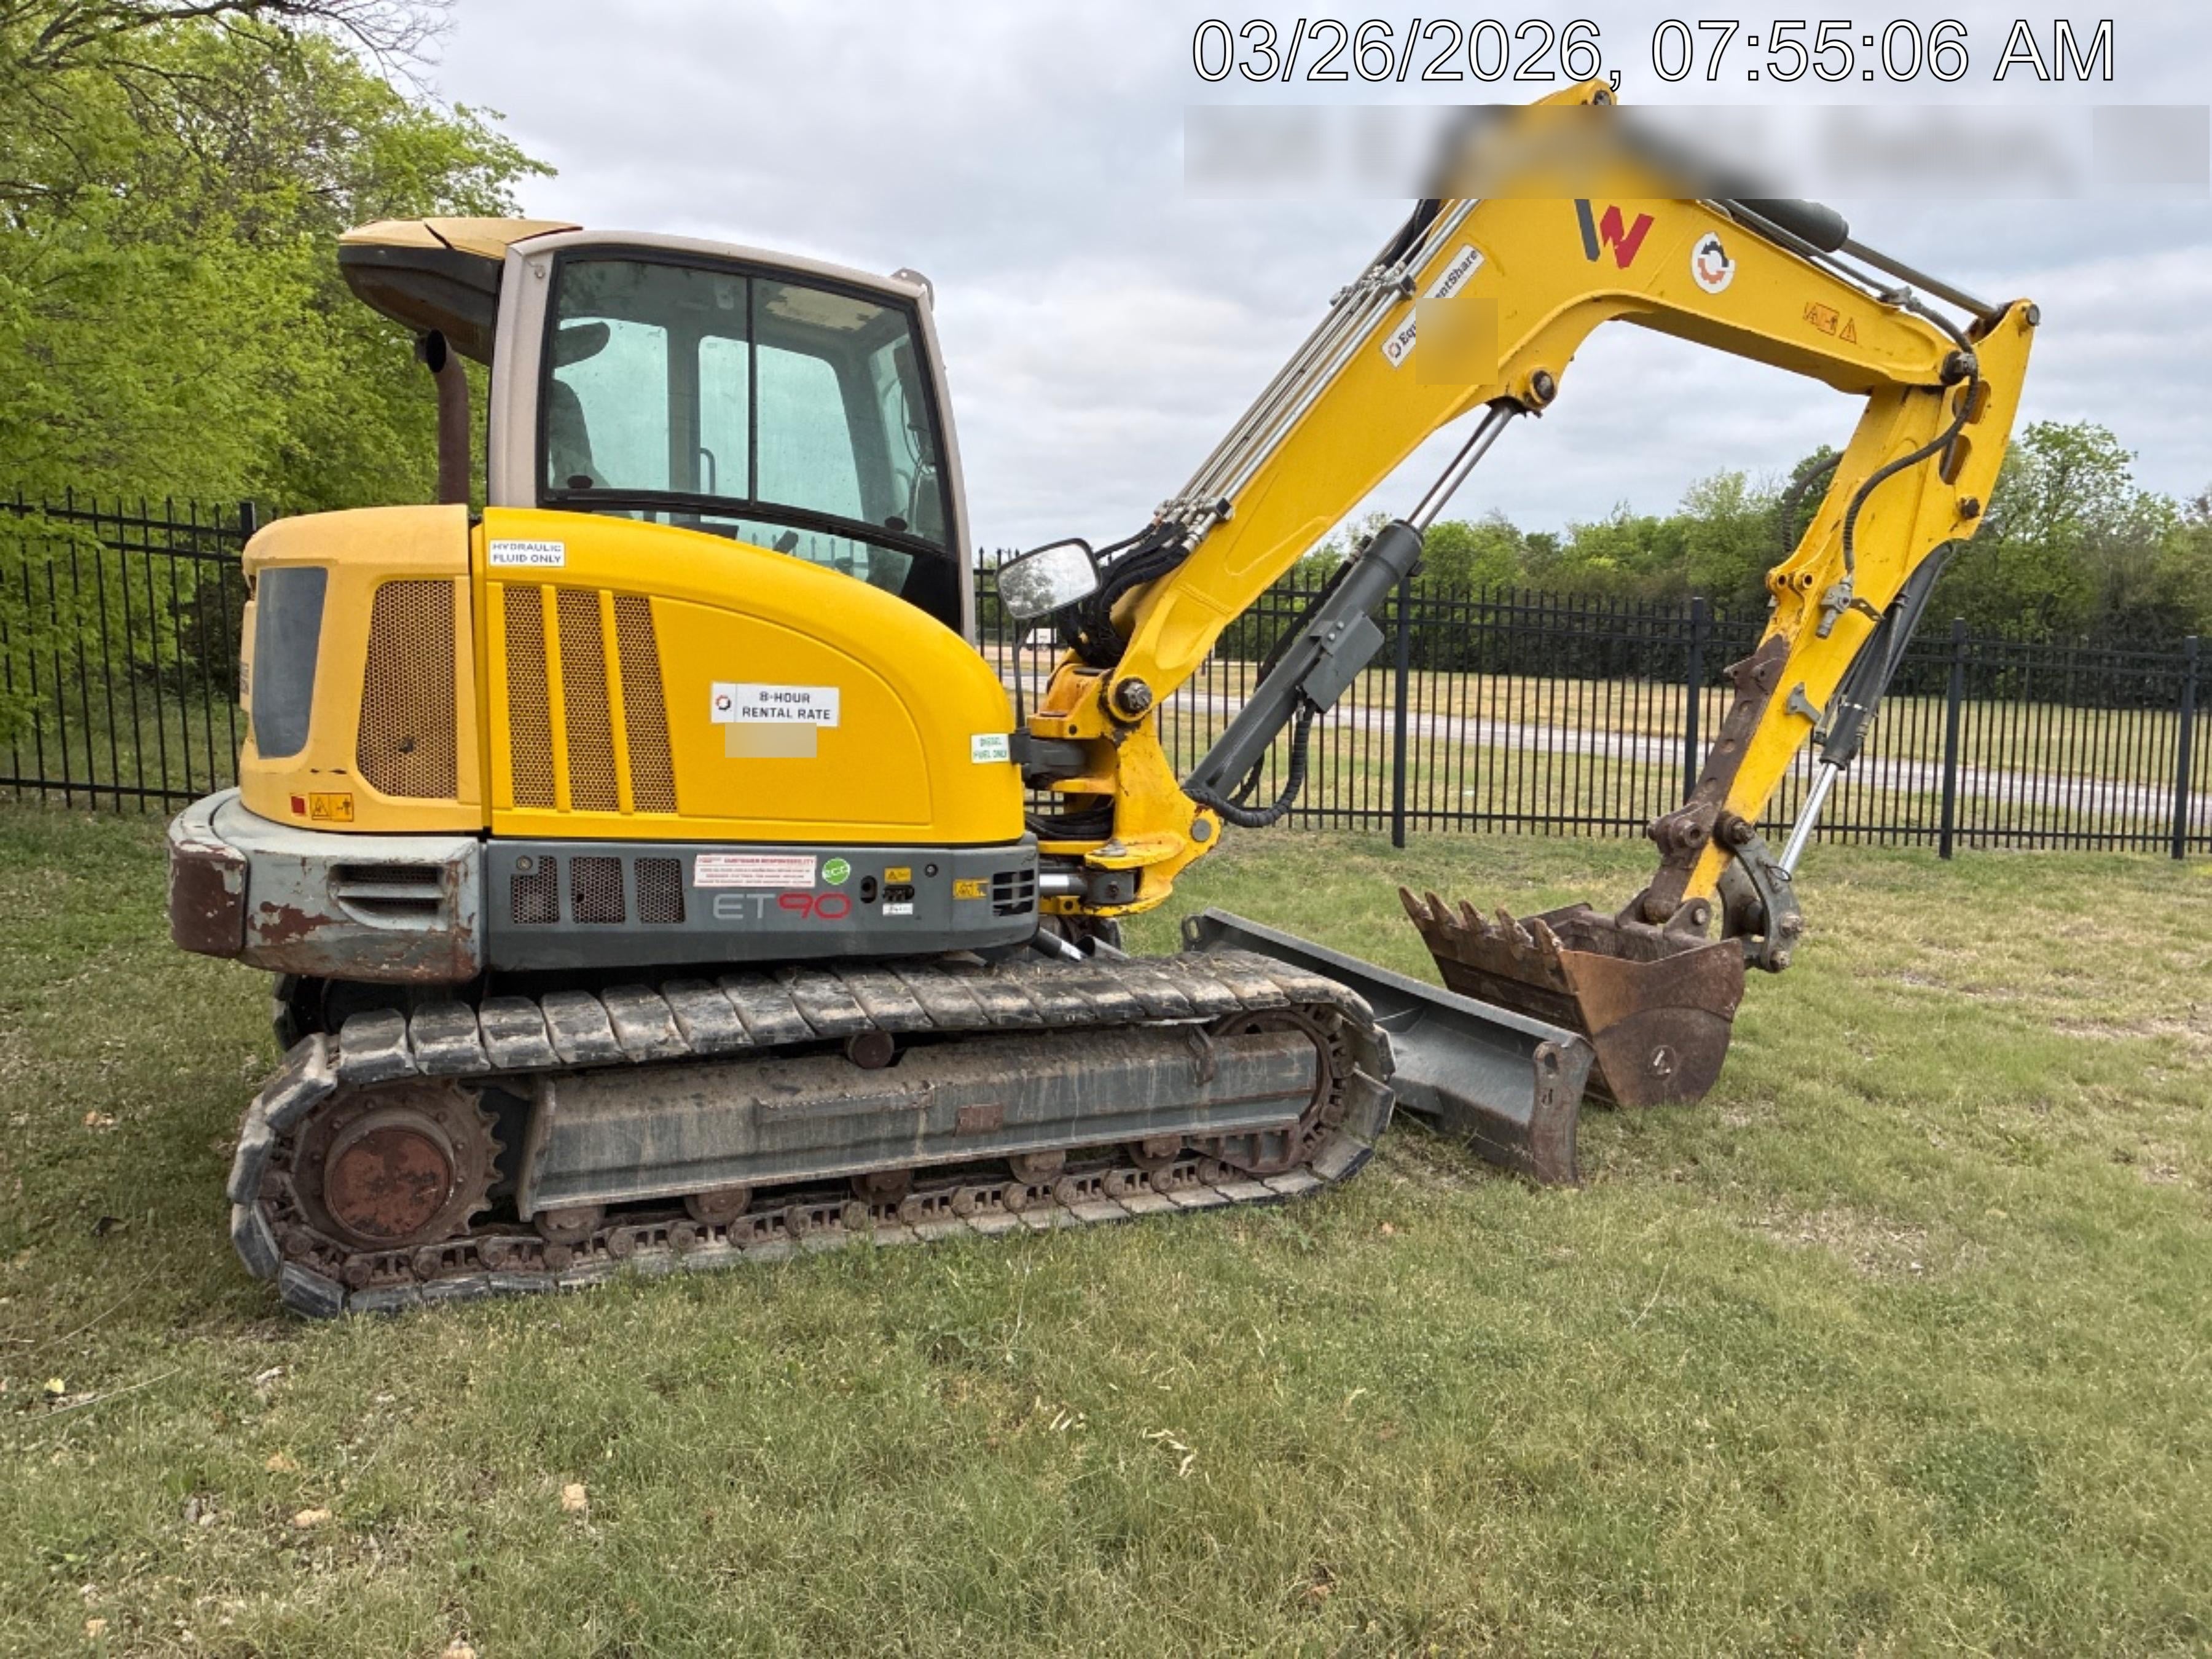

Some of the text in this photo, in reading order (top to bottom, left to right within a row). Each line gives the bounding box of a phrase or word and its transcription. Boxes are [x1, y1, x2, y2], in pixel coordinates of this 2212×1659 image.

[493, 543, 561, 552] HYDRAULIC
[493, 554, 561, 563] FLUID ONLY
[759, 691, 810, 704] 8-HOUR
[742, 706, 830, 720] RENTAL RATE
[713, 892, 852, 920] ET90
